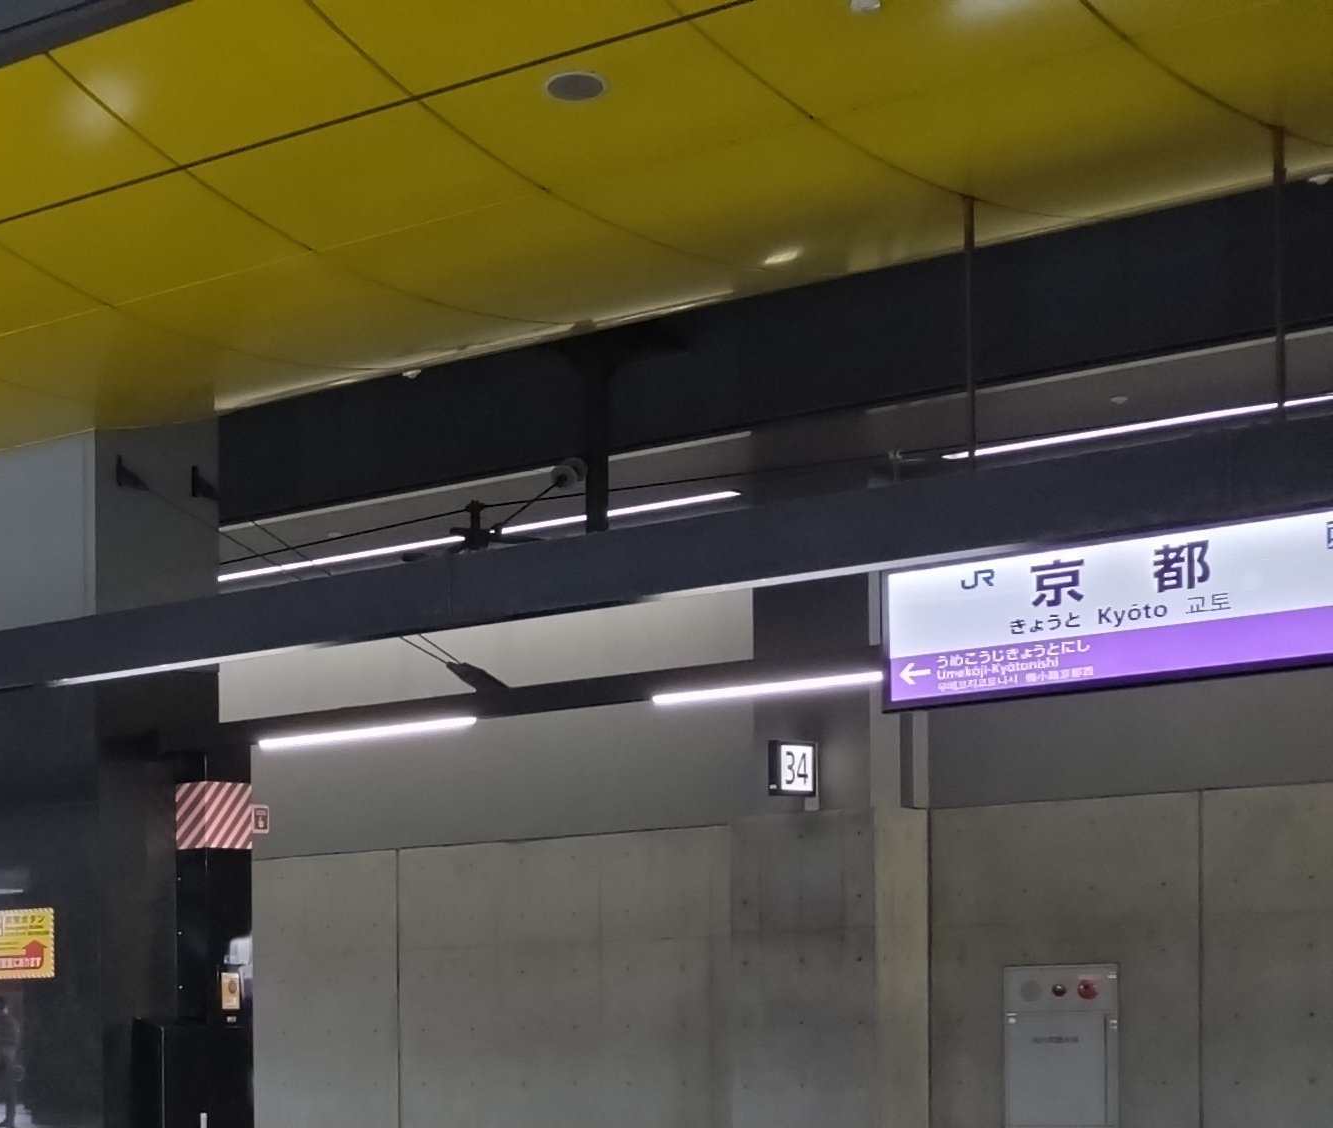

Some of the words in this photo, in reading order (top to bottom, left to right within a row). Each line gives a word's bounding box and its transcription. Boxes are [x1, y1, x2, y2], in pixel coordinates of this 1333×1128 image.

[961, 568, 994, 590] JR
[1009, 611, 1081, 635] きょうと
[1097, 602, 1169, 628] Kyōto
[1185, 592, 1232, 614] 교토
[785, 750, 809, 785] 34
